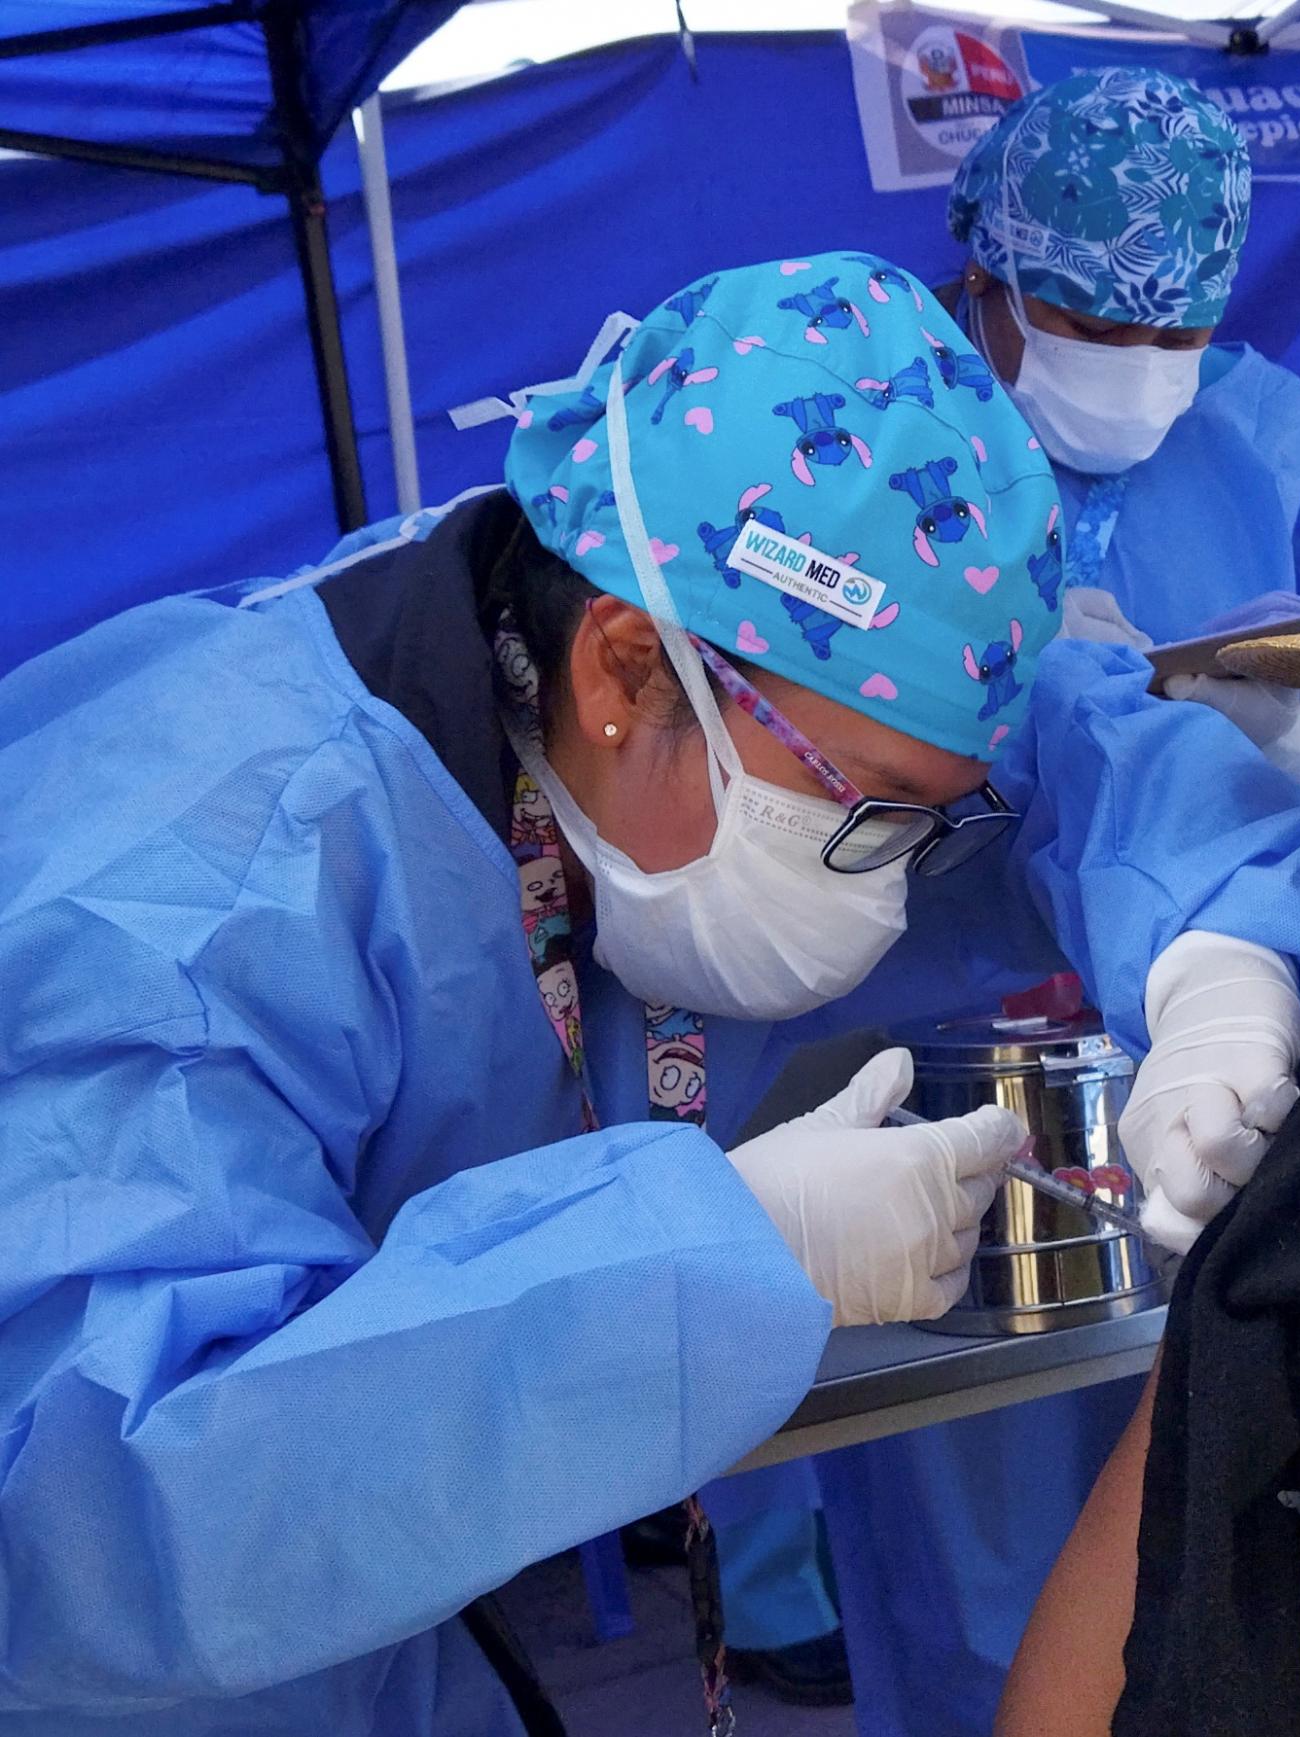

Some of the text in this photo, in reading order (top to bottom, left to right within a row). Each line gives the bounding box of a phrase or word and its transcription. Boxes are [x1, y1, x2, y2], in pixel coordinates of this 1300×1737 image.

[943, 97, 1005, 116] MINSA
[745, 531, 841, 589] WIZARD MED
[773, 571, 829, 603] AUTHENTIC
